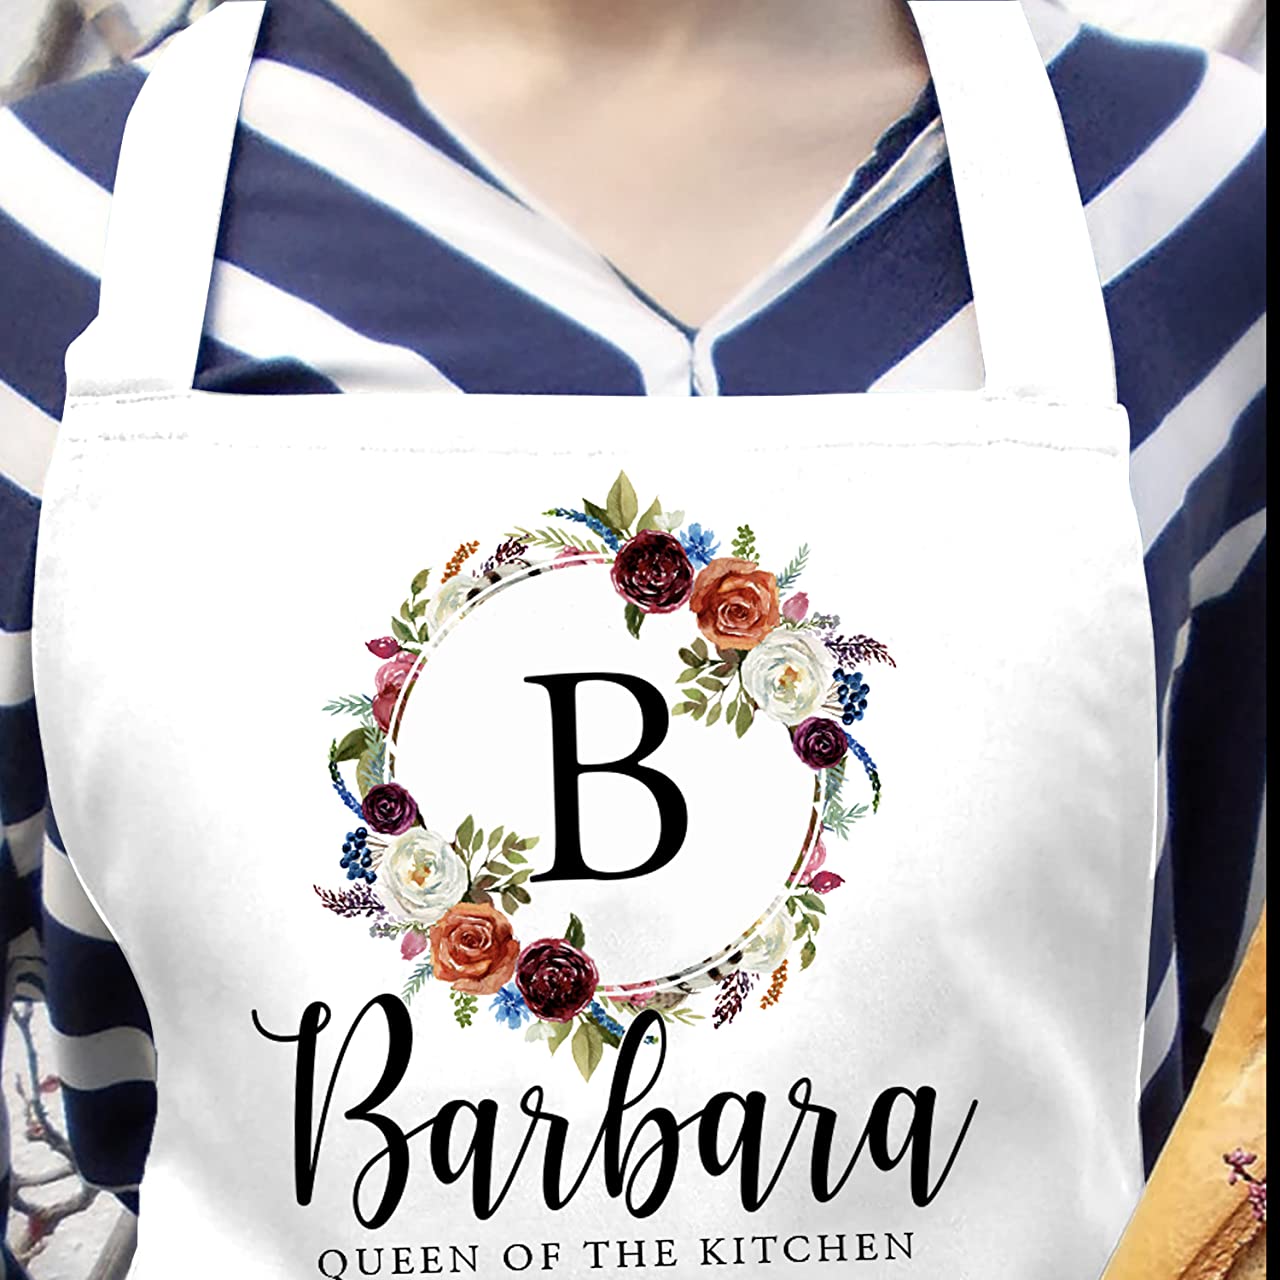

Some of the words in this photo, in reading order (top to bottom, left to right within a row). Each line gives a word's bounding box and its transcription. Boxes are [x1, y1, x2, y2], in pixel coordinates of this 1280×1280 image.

[525, 671, 688, 883] B
[252, 994, 978, 1229] Barbara
[503, 1242, 560, 1271] OF
[582, 1239, 678, 1269] THE
[699, 1232, 914, 1266] KITCHEN
